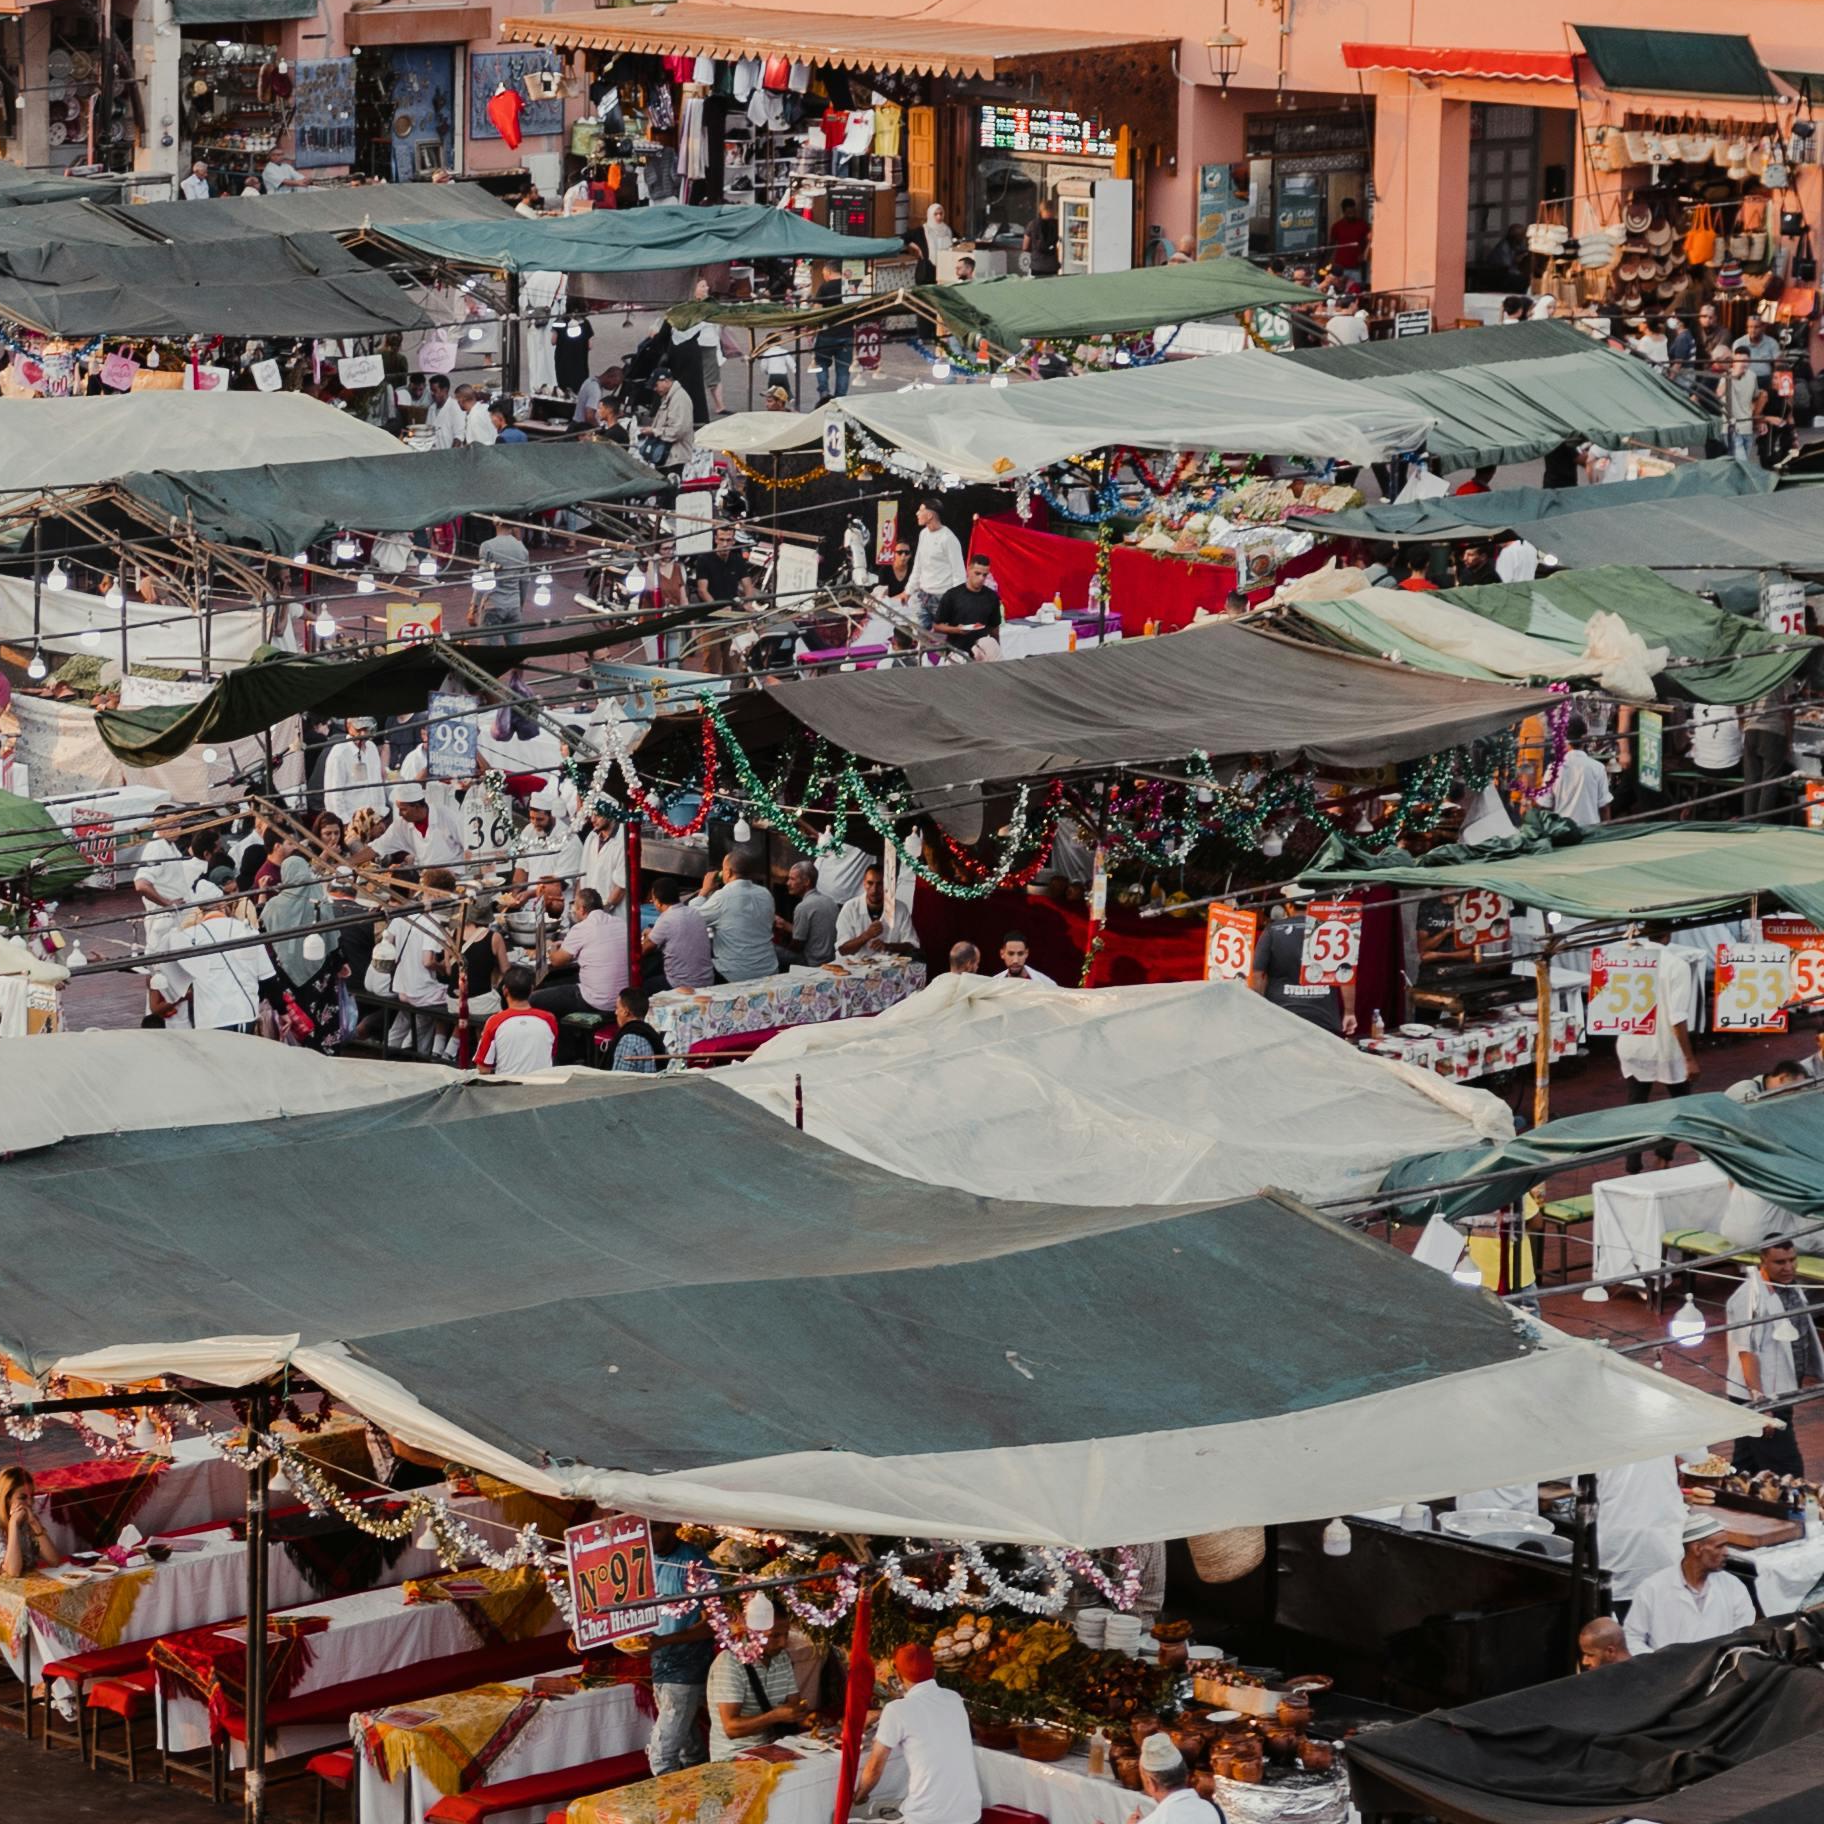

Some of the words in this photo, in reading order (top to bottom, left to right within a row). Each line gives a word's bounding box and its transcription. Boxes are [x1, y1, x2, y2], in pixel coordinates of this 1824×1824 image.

[1258, 312, 1289, 337] 26
[857, 334, 879, 357] 26
[436, 723, 470, 754] 98
[467, 815, 511, 850] 36
[1465, 888, 1502, 924] 53
[1767, 926, 1790, 934] CHEZ
[1215, 933, 1245, 969] 53
[1313, 928, 1351, 962] 53
[1719, 949, 1756, 966] حسن
[1760, 951, 1787, 964] عند
[1592, 950, 1629, 972] حسن
[1632, 957, 1658, 969] عند
[1607, 972, 1656, 1015] 53
[1736, 967, 1785, 1010] 53
[1593, 1016, 1656, 1034] باولو
[1720, 1013, 1784, 1029] باولو
[572, 1525, 613, 1562] هشام
[613, 1520, 646, 1545] عند
[579, 1545, 648, 1614] N°97
[581, 1617, 610, 1642] Chez
[610, 1605, 657, 1634] Hicham
